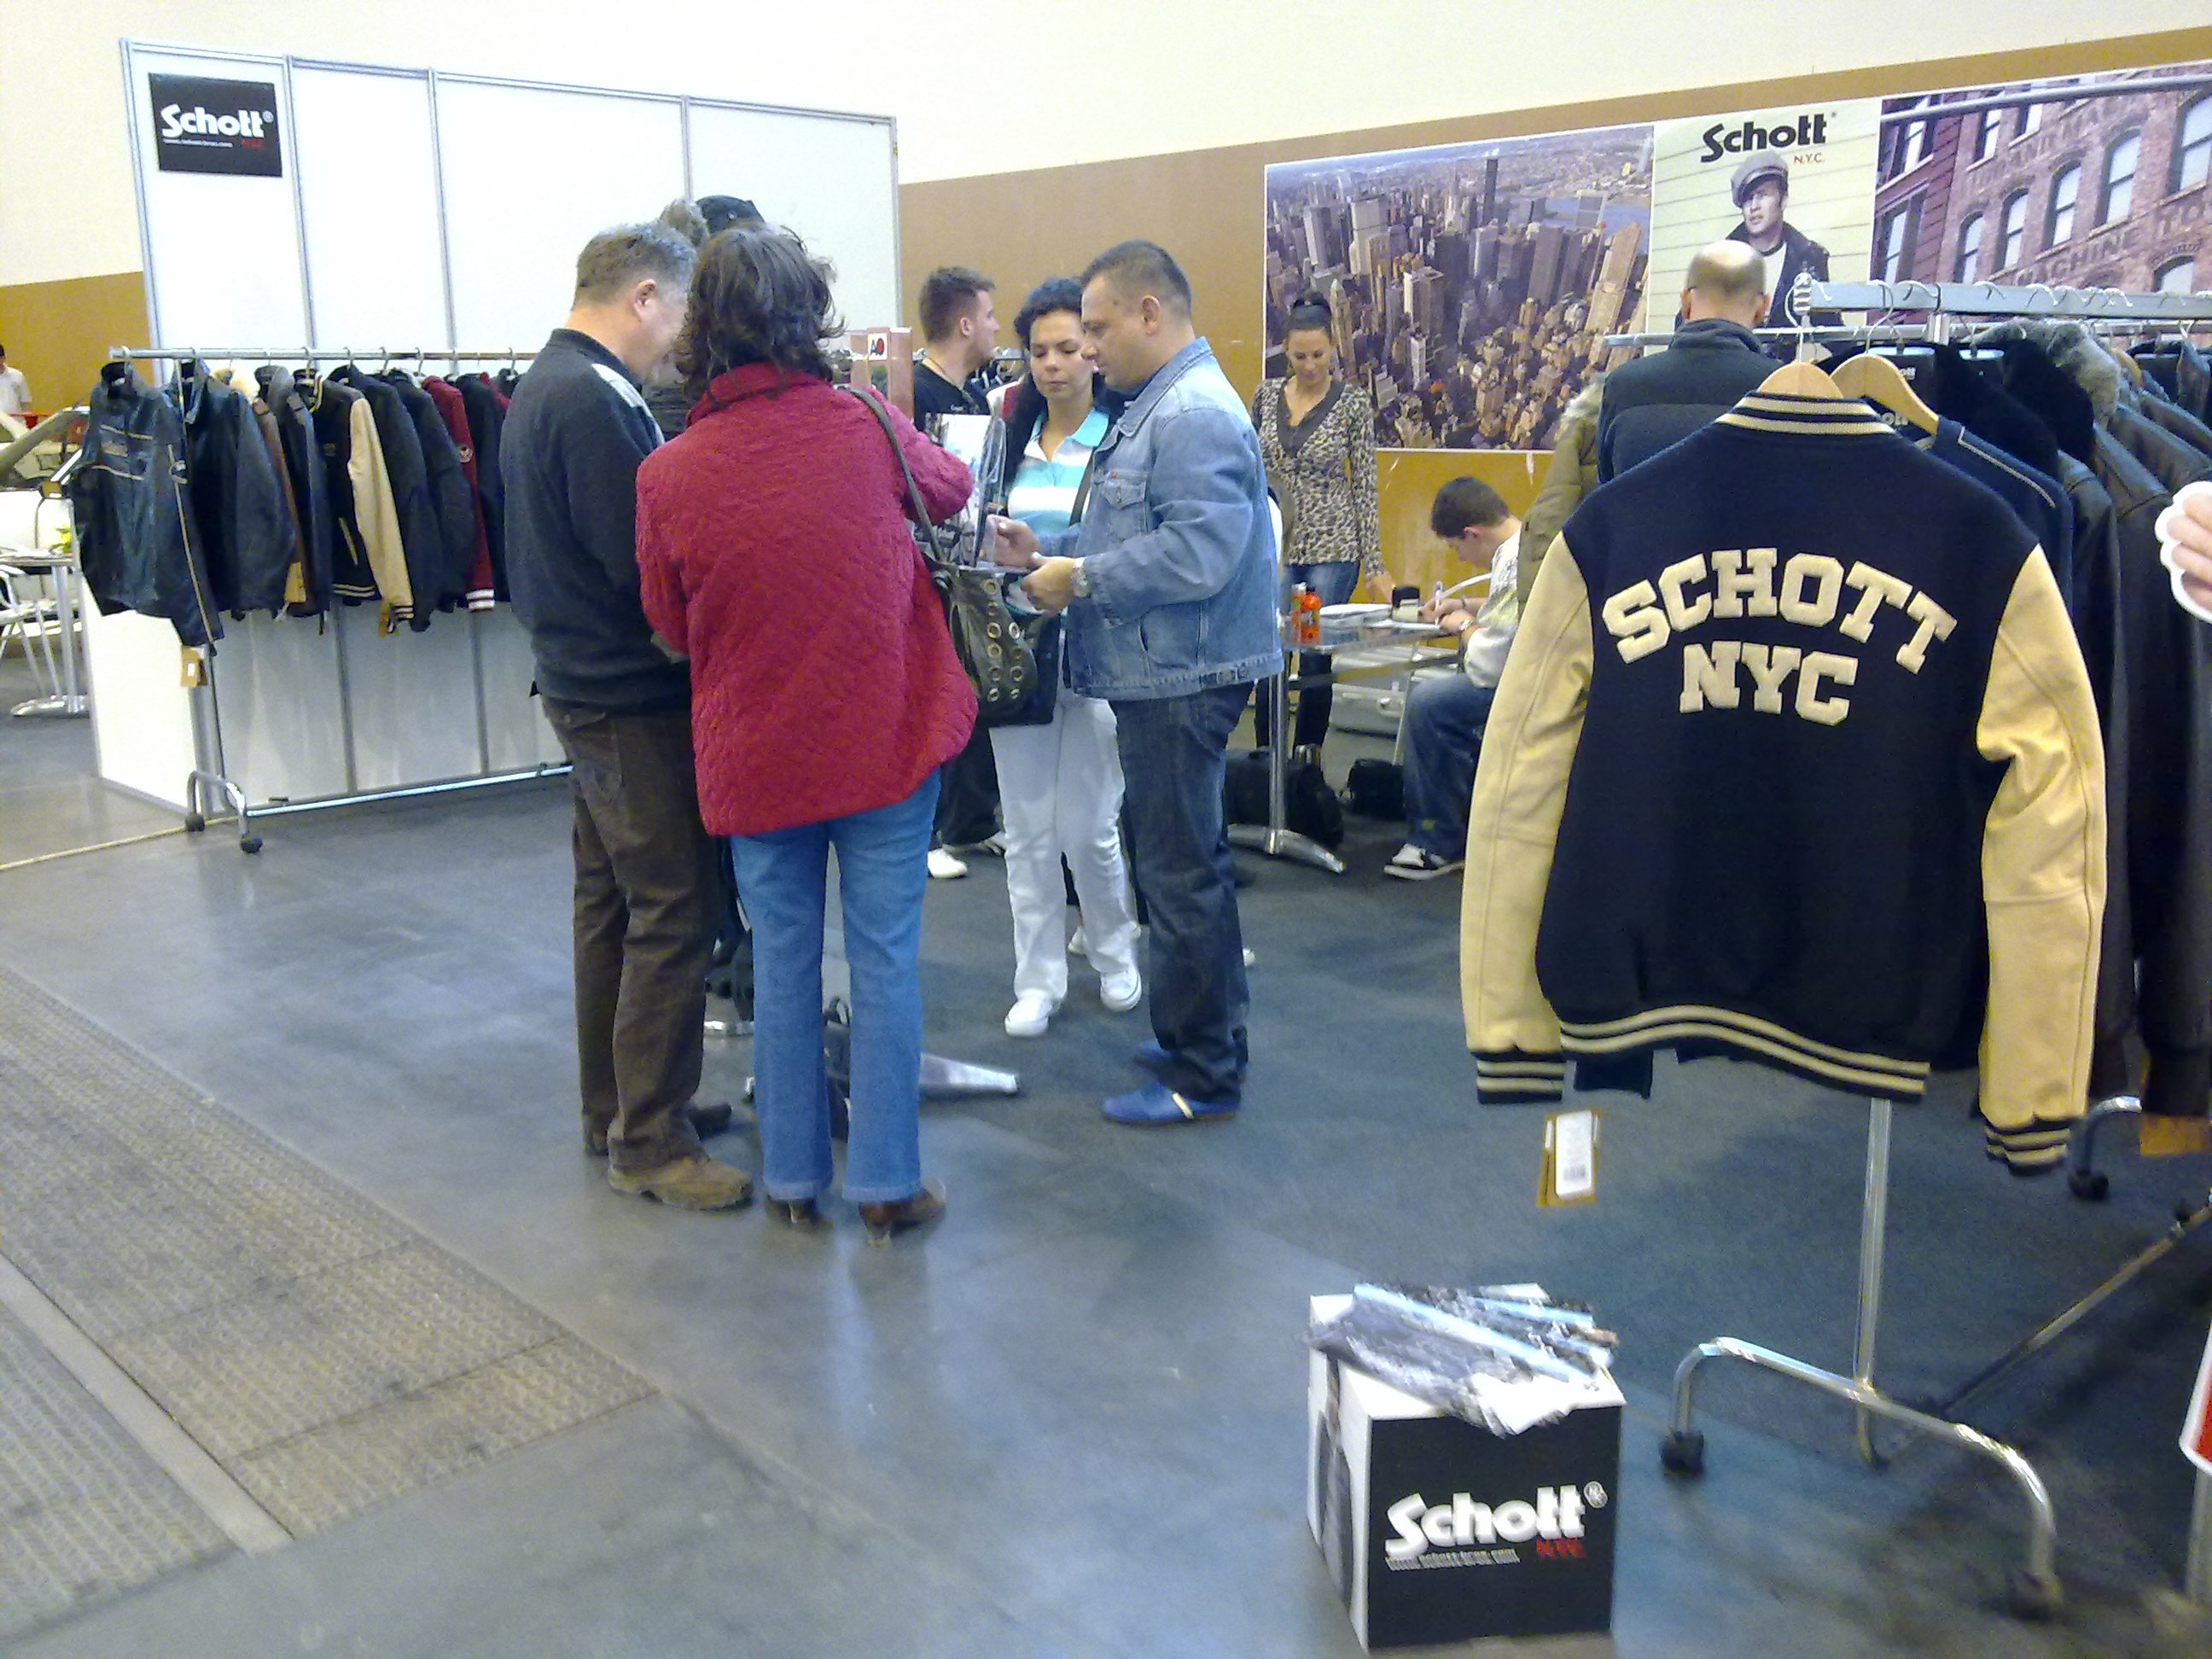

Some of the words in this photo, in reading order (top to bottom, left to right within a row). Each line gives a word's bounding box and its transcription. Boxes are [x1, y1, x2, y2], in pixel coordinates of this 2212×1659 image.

[160, 103, 265, 138] Schott
[1700, 113, 1828, 164] Schott
[1602, 546, 1959, 675] SCHOTT
[1678, 639, 1860, 727] NYC
[1384, 1482, 1586, 1559] Schott
